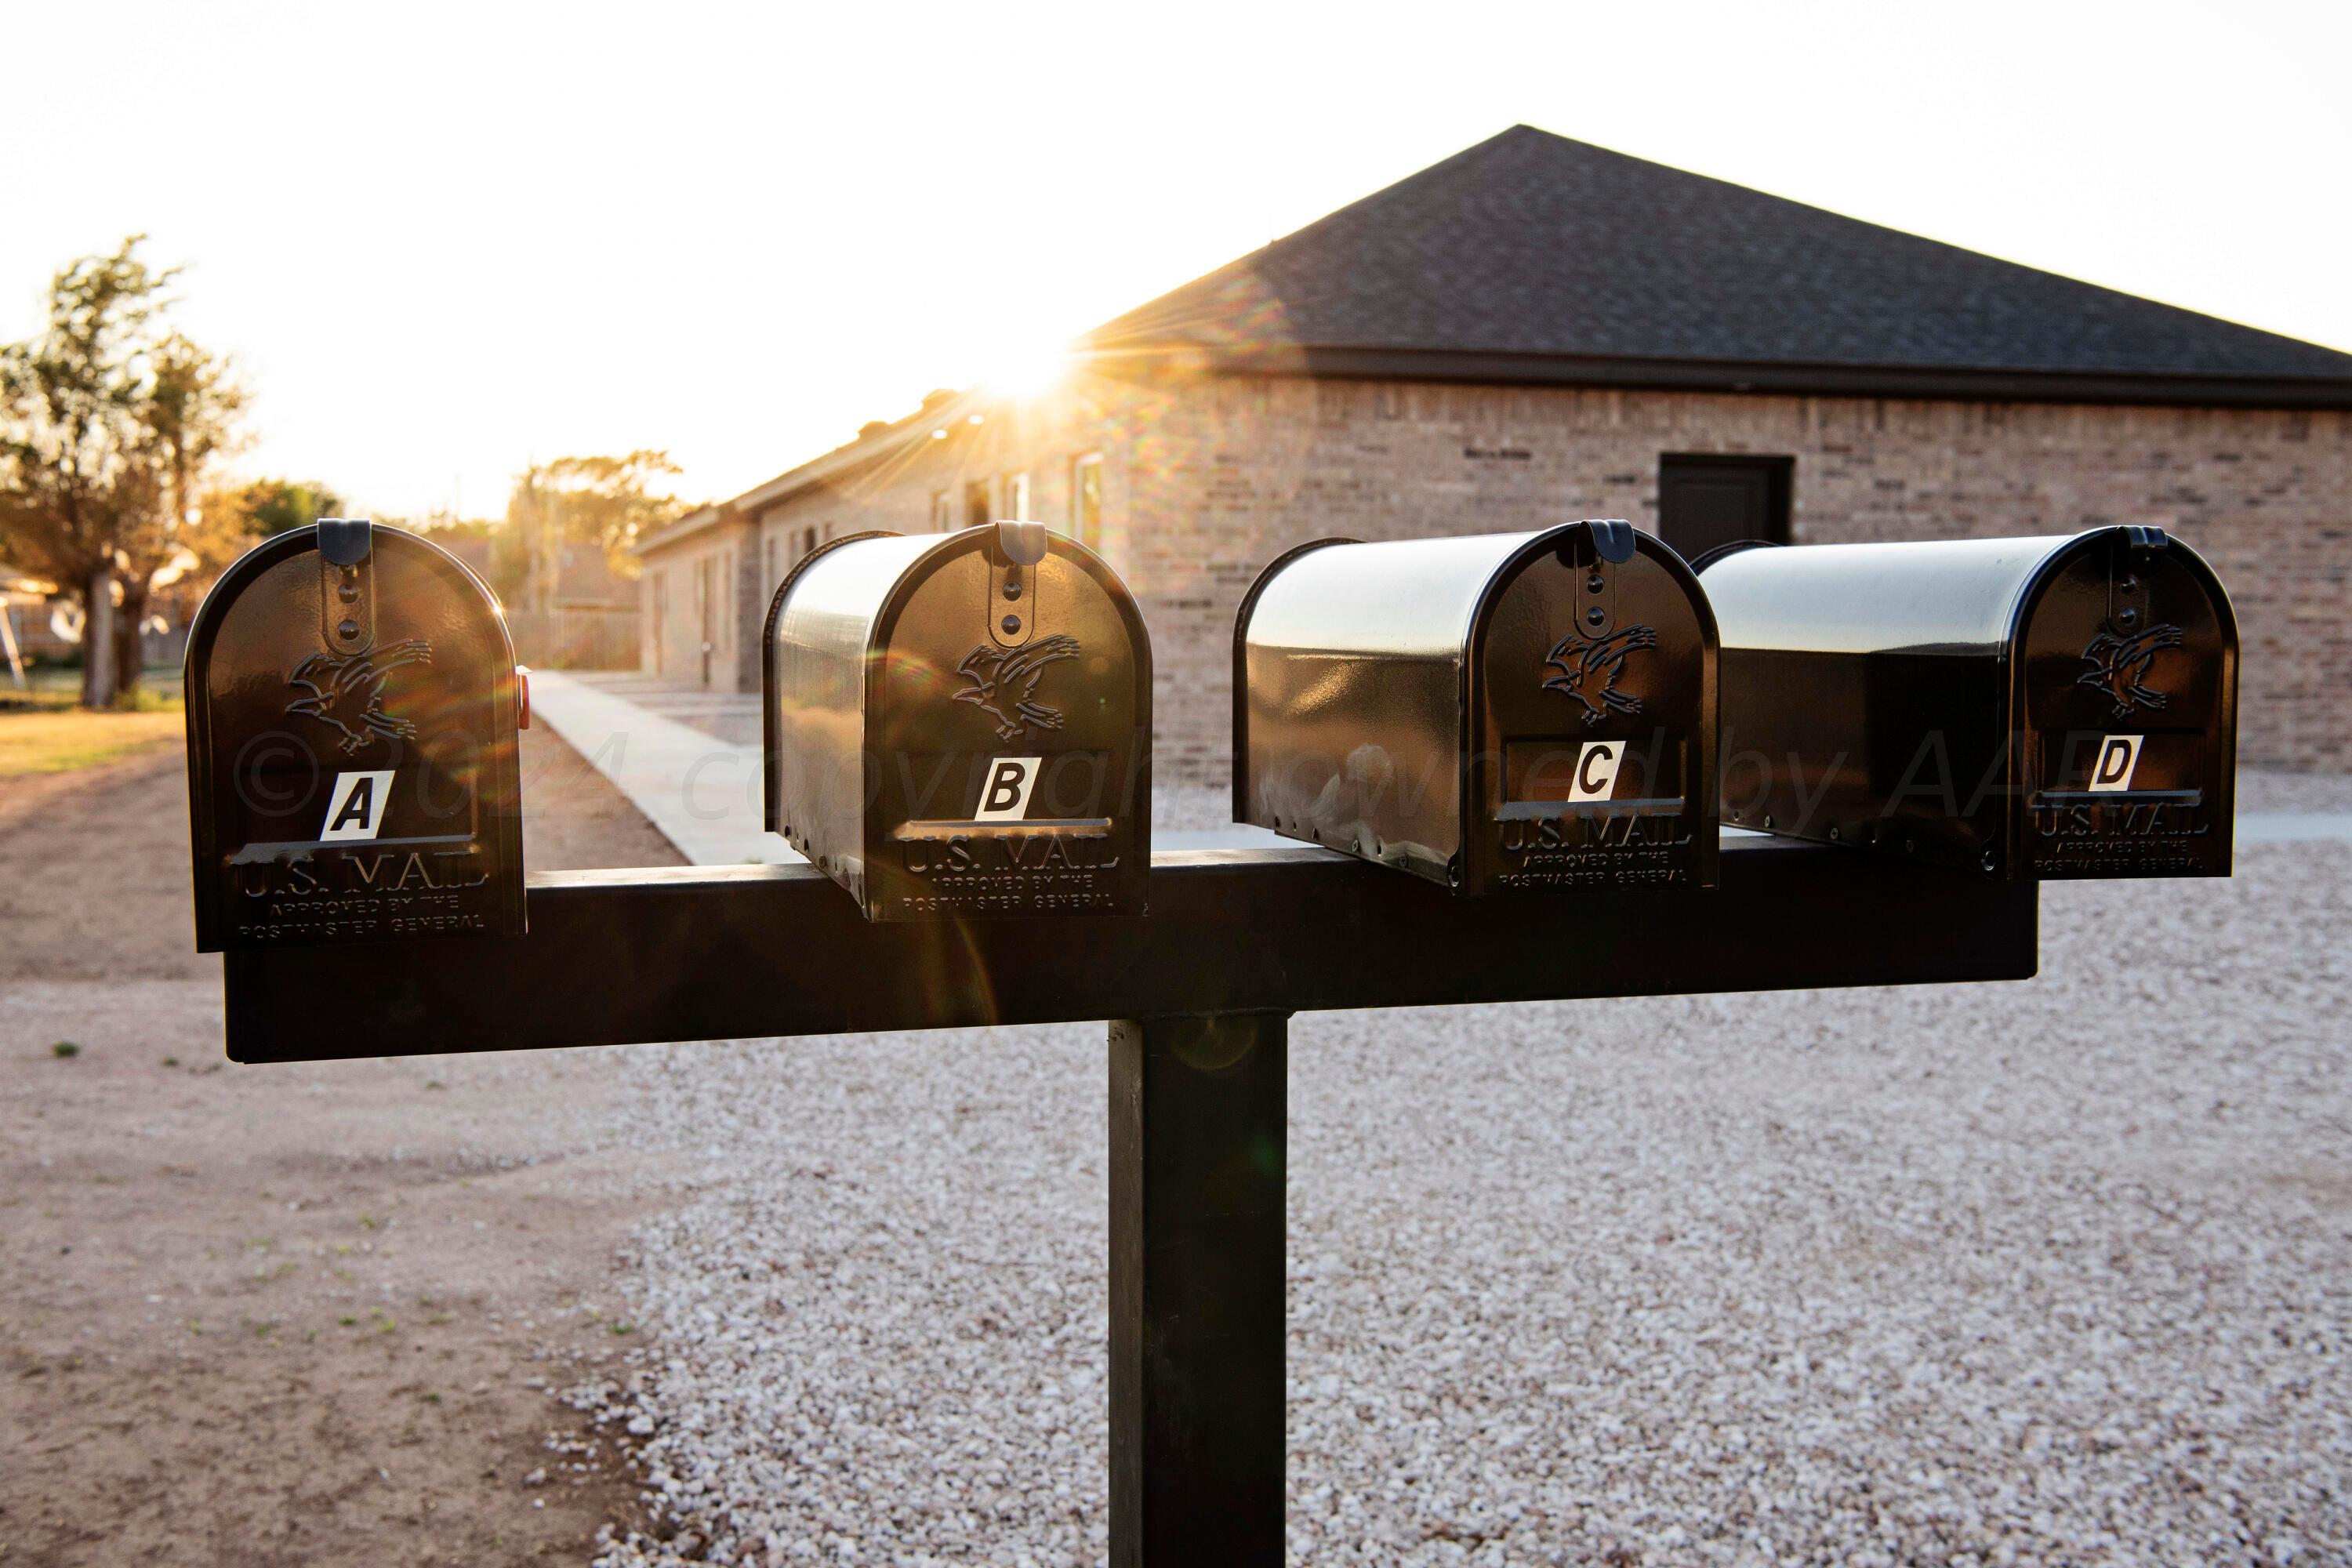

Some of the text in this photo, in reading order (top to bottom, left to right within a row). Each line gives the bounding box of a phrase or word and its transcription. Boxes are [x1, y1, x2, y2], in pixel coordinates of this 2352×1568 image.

[1577, 745, 1613, 794] C
[2096, 739, 2133, 785] D
[329, 776, 373, 831] A
[983, 762, 1026, 812] B
[1493, 815, 1570, 852] U.S.
[2031, 803, 2100, 837] U.S.
[898, 834, 981, 873] U.S.
[232, 856, 330, 898] U.S.
